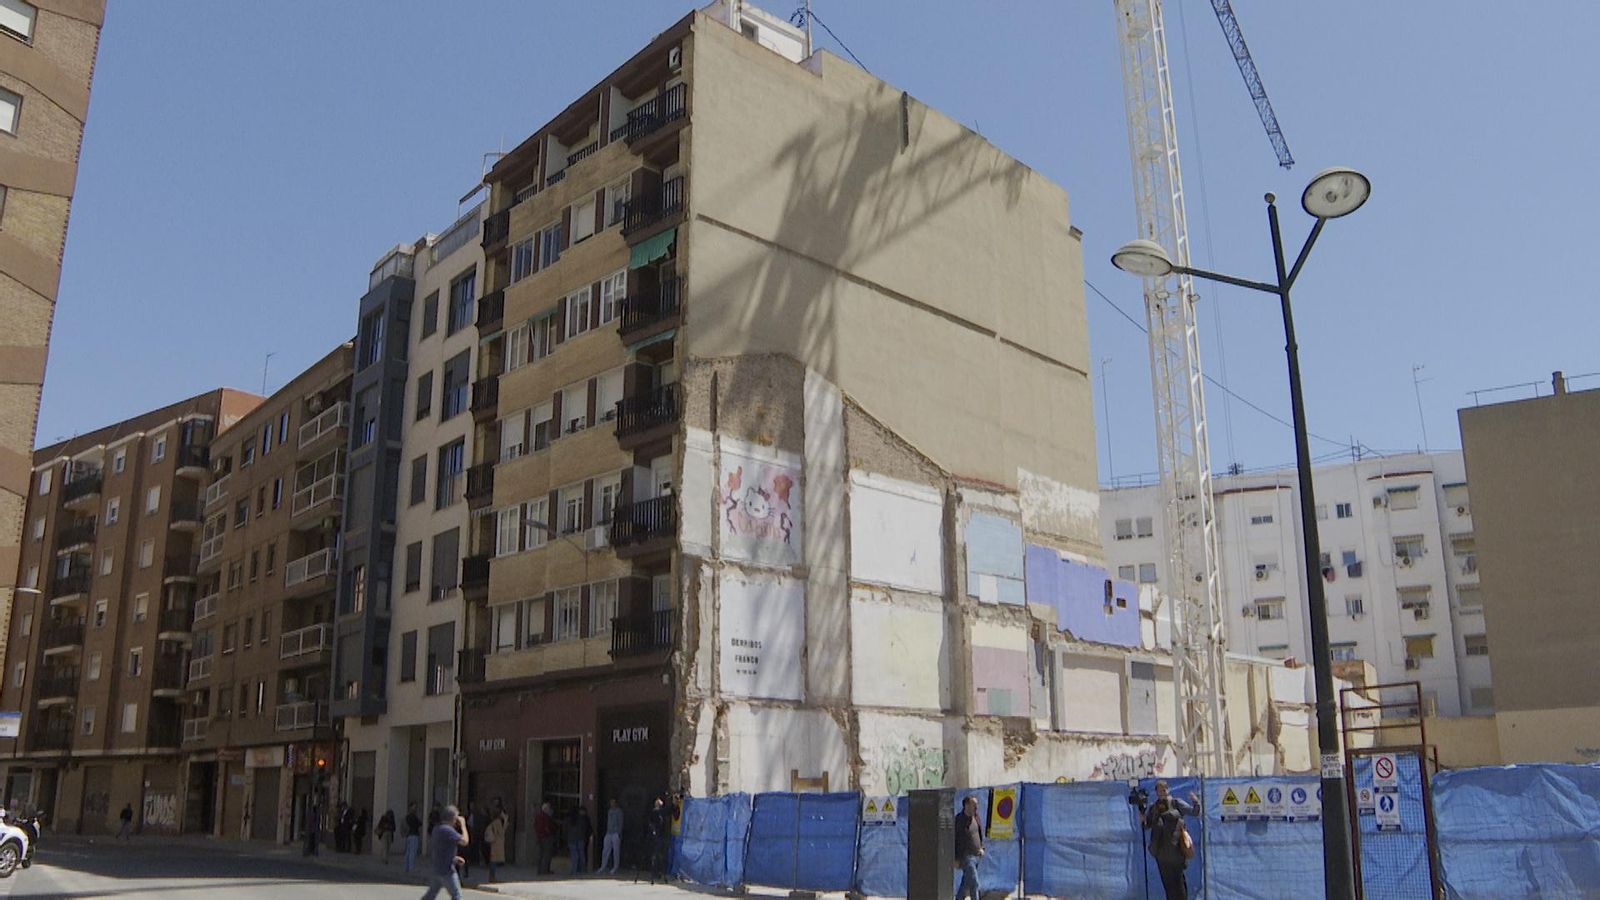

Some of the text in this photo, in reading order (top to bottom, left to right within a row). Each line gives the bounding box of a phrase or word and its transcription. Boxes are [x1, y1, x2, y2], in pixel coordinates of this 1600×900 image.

[735, 655, 759, 664] FRANCO
[612, 726, 649, 742] PLAY GYM
